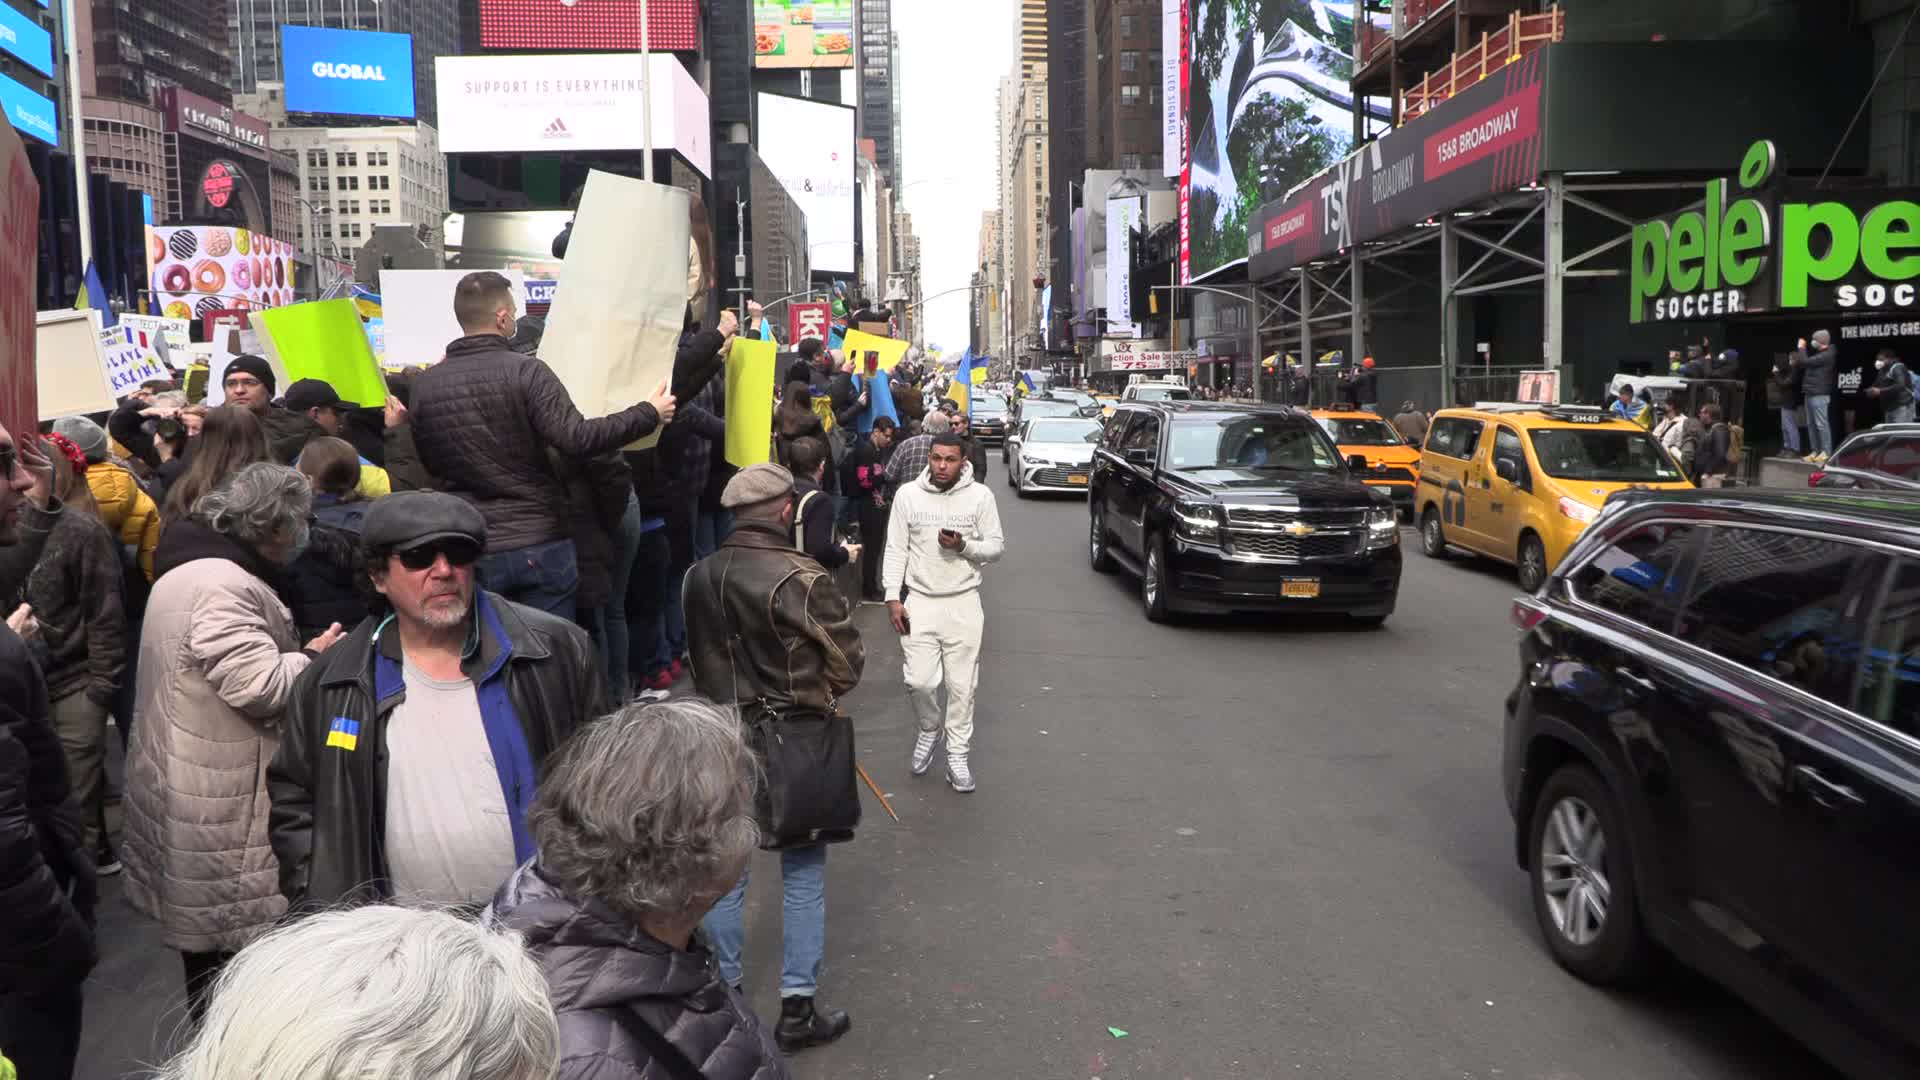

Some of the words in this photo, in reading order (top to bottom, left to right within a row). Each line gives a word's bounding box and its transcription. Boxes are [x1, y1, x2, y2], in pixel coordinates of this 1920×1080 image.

[311, 61, 386, 81] GLOBAL
[464, 80, 528, 94] SUPPORT
[535, 80, 549, 93] IS
[1166, 95, 1176, 136] SIGNAGE
[1437, 137, 1457, 163] 1568
[1458, 106, 1519, 154] BROADWAY
[1372, 153, 1415, 204] BROADWAY
[1180, 184, 1189, 251] COME
[1321, 160, 1352, 250] TSX
[1280, 214, 1305, 239] BROADWAY
[1656, 290, 1741, 320] SOCCER
[1837, 284, 1914, 307] SOC
[1841, 326, 1858, 339] THE
[1859, 323, 1899, 338] WORLD'S
[1140, 352, 1160, 361] Sale
[1838, 366, 1862, 388] pelé
